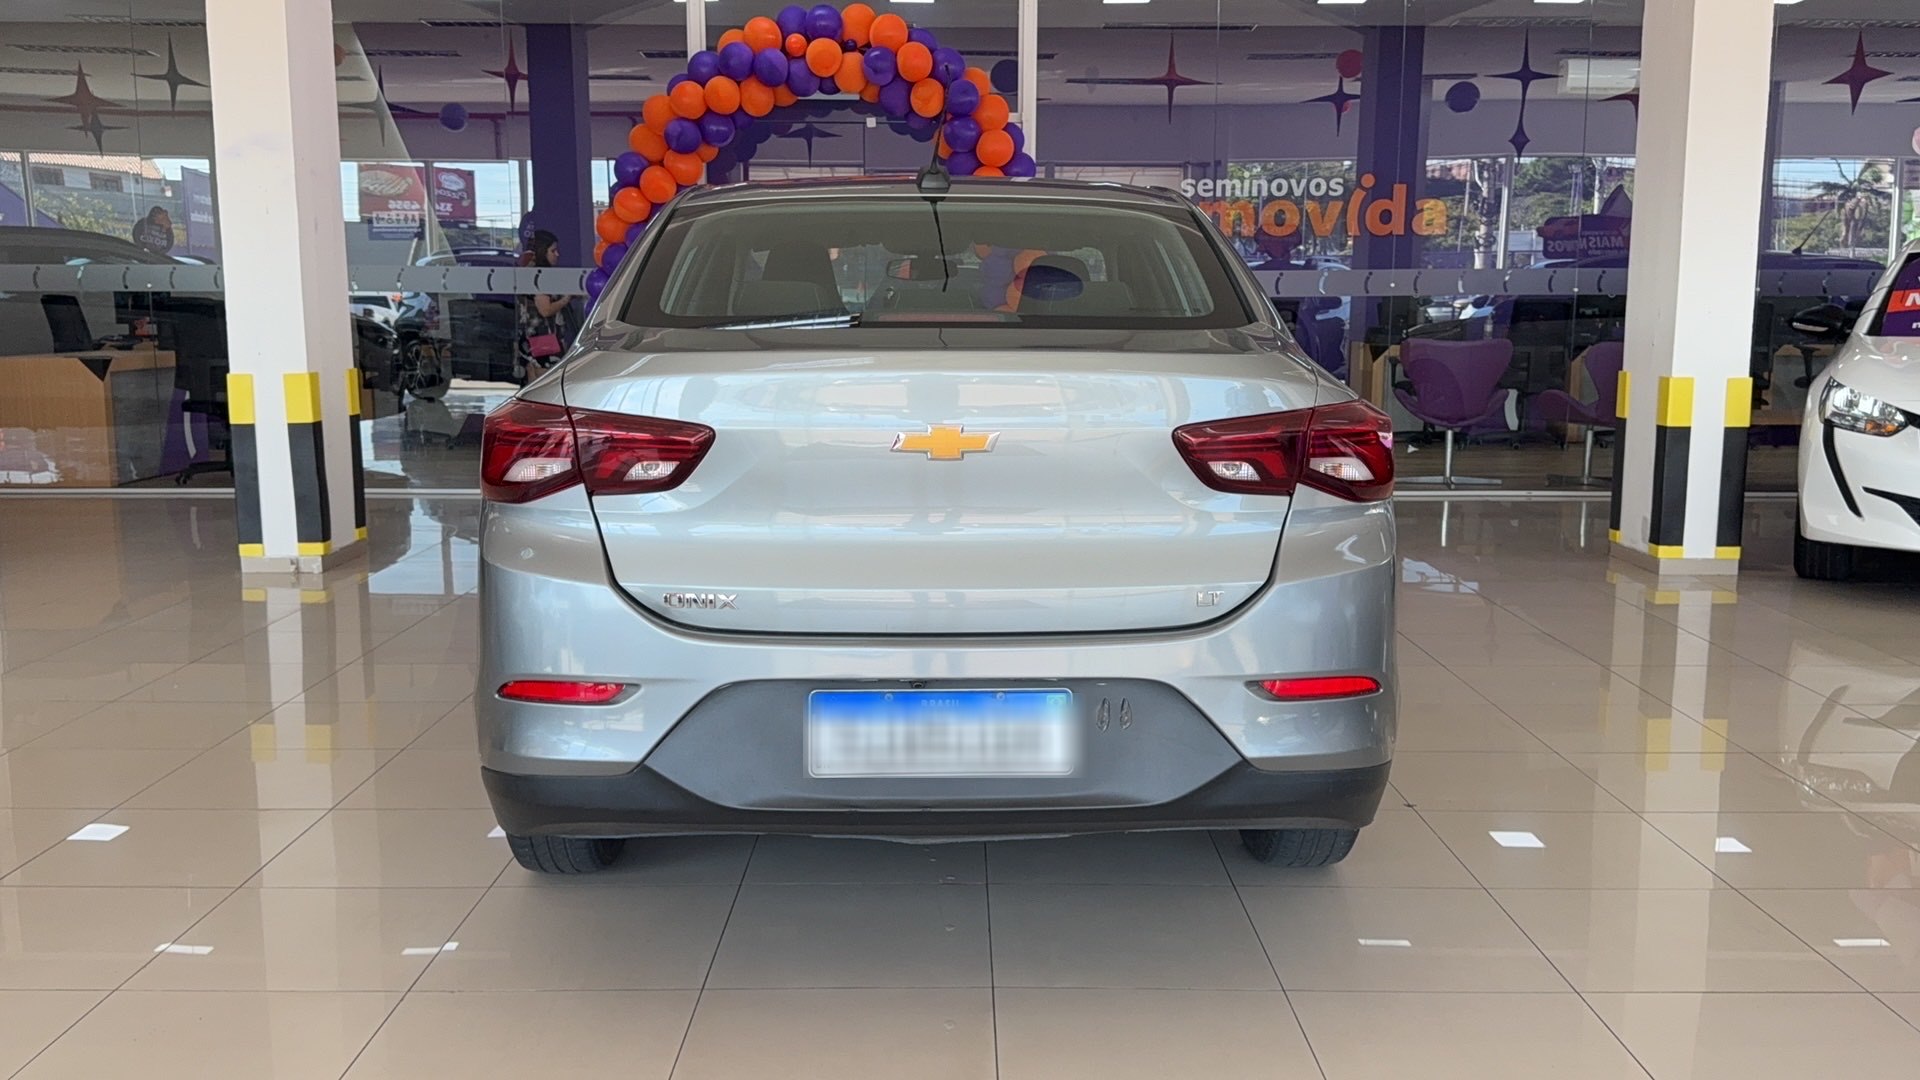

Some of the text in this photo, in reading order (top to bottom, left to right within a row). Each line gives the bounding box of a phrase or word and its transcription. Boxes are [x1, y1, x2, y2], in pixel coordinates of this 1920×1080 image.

[1180, 177, 1345, 198] seminovos
[663, 592, 738, 609] ONIX
[1196, 590, 1225, 607] LT
